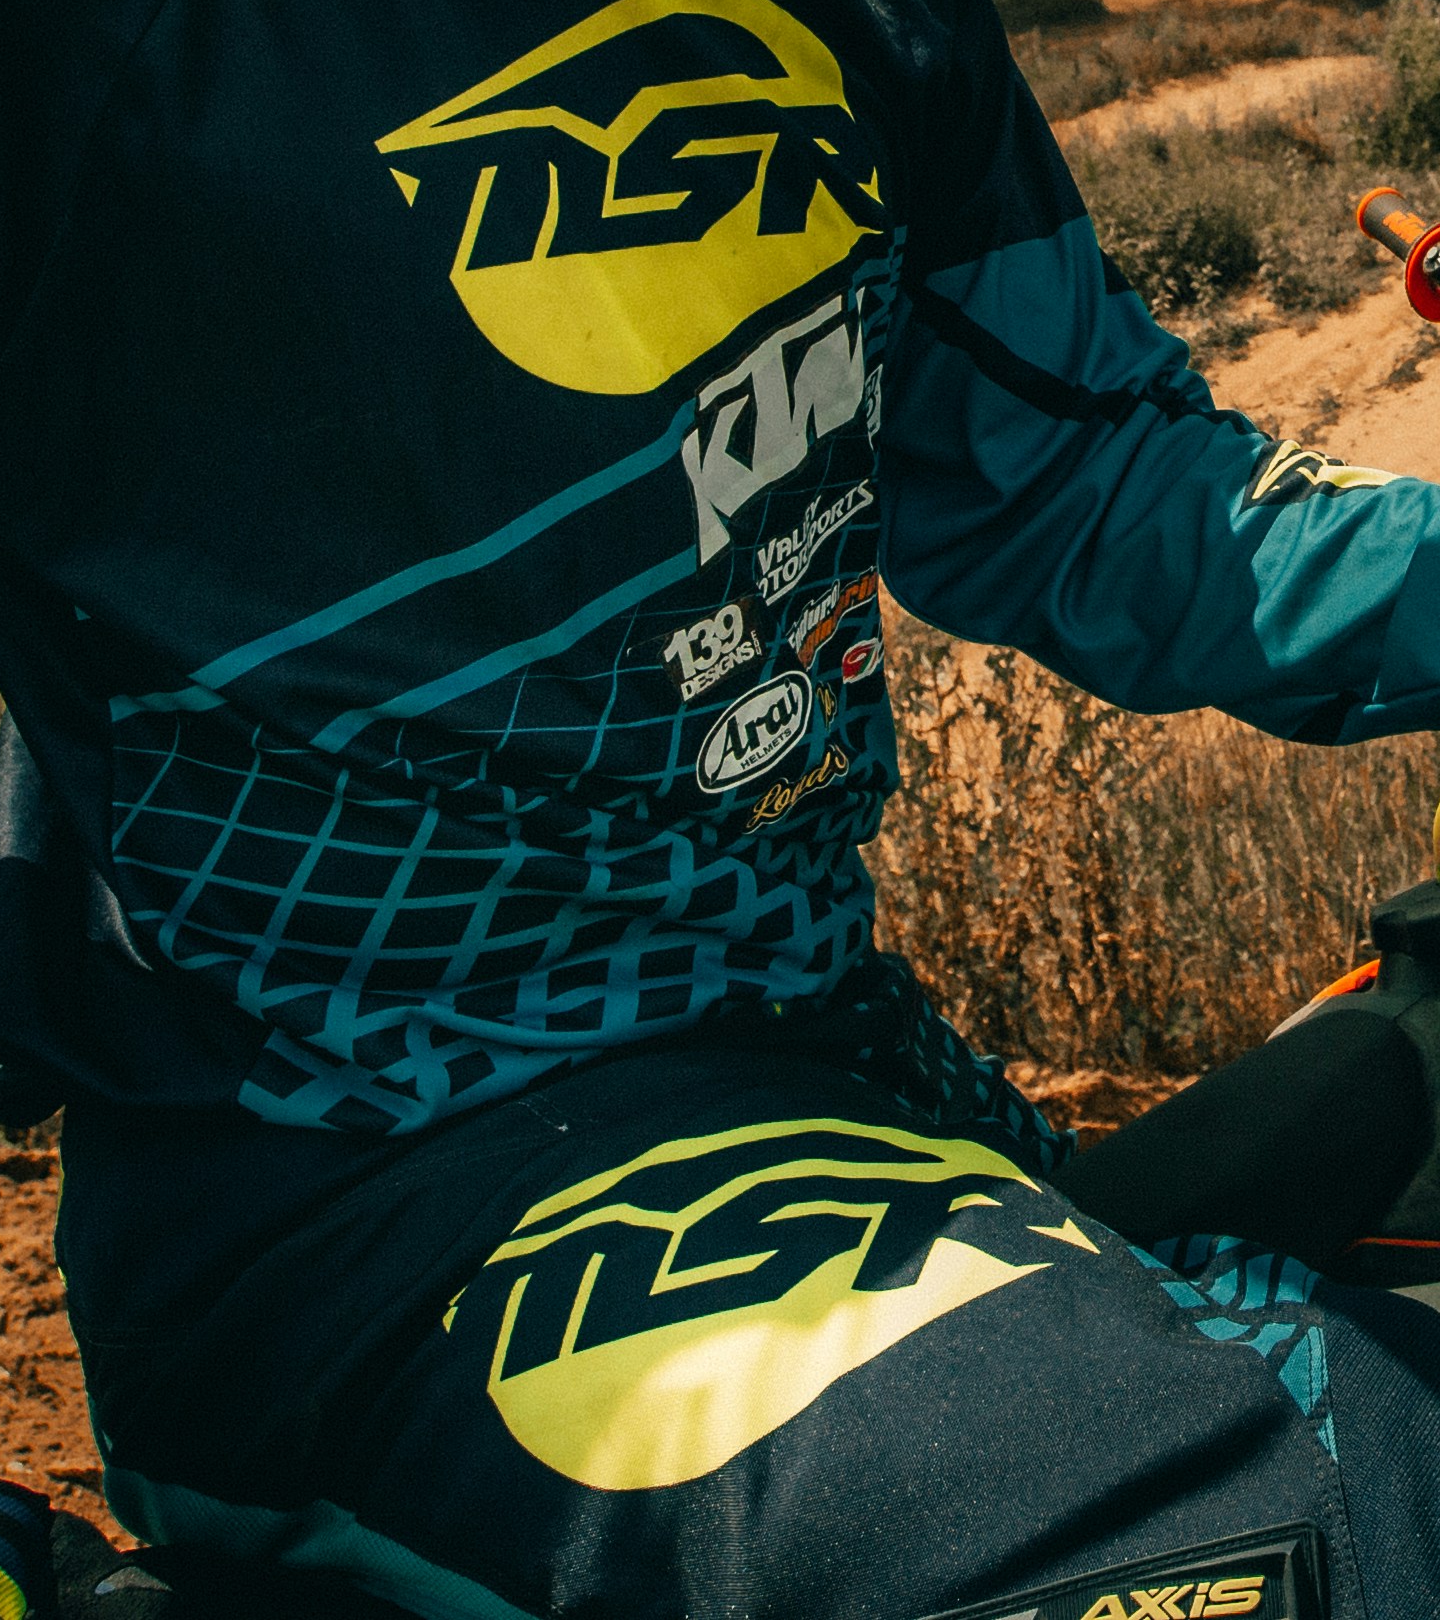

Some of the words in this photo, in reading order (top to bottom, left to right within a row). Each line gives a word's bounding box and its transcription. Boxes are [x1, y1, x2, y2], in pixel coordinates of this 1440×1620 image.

[664, 604, 744, 680] 139
[681, 642, 756, 701] DESIGNS
[710, 677, 800, 785] Arai
[740, 728, 793, 770] HELMETS
